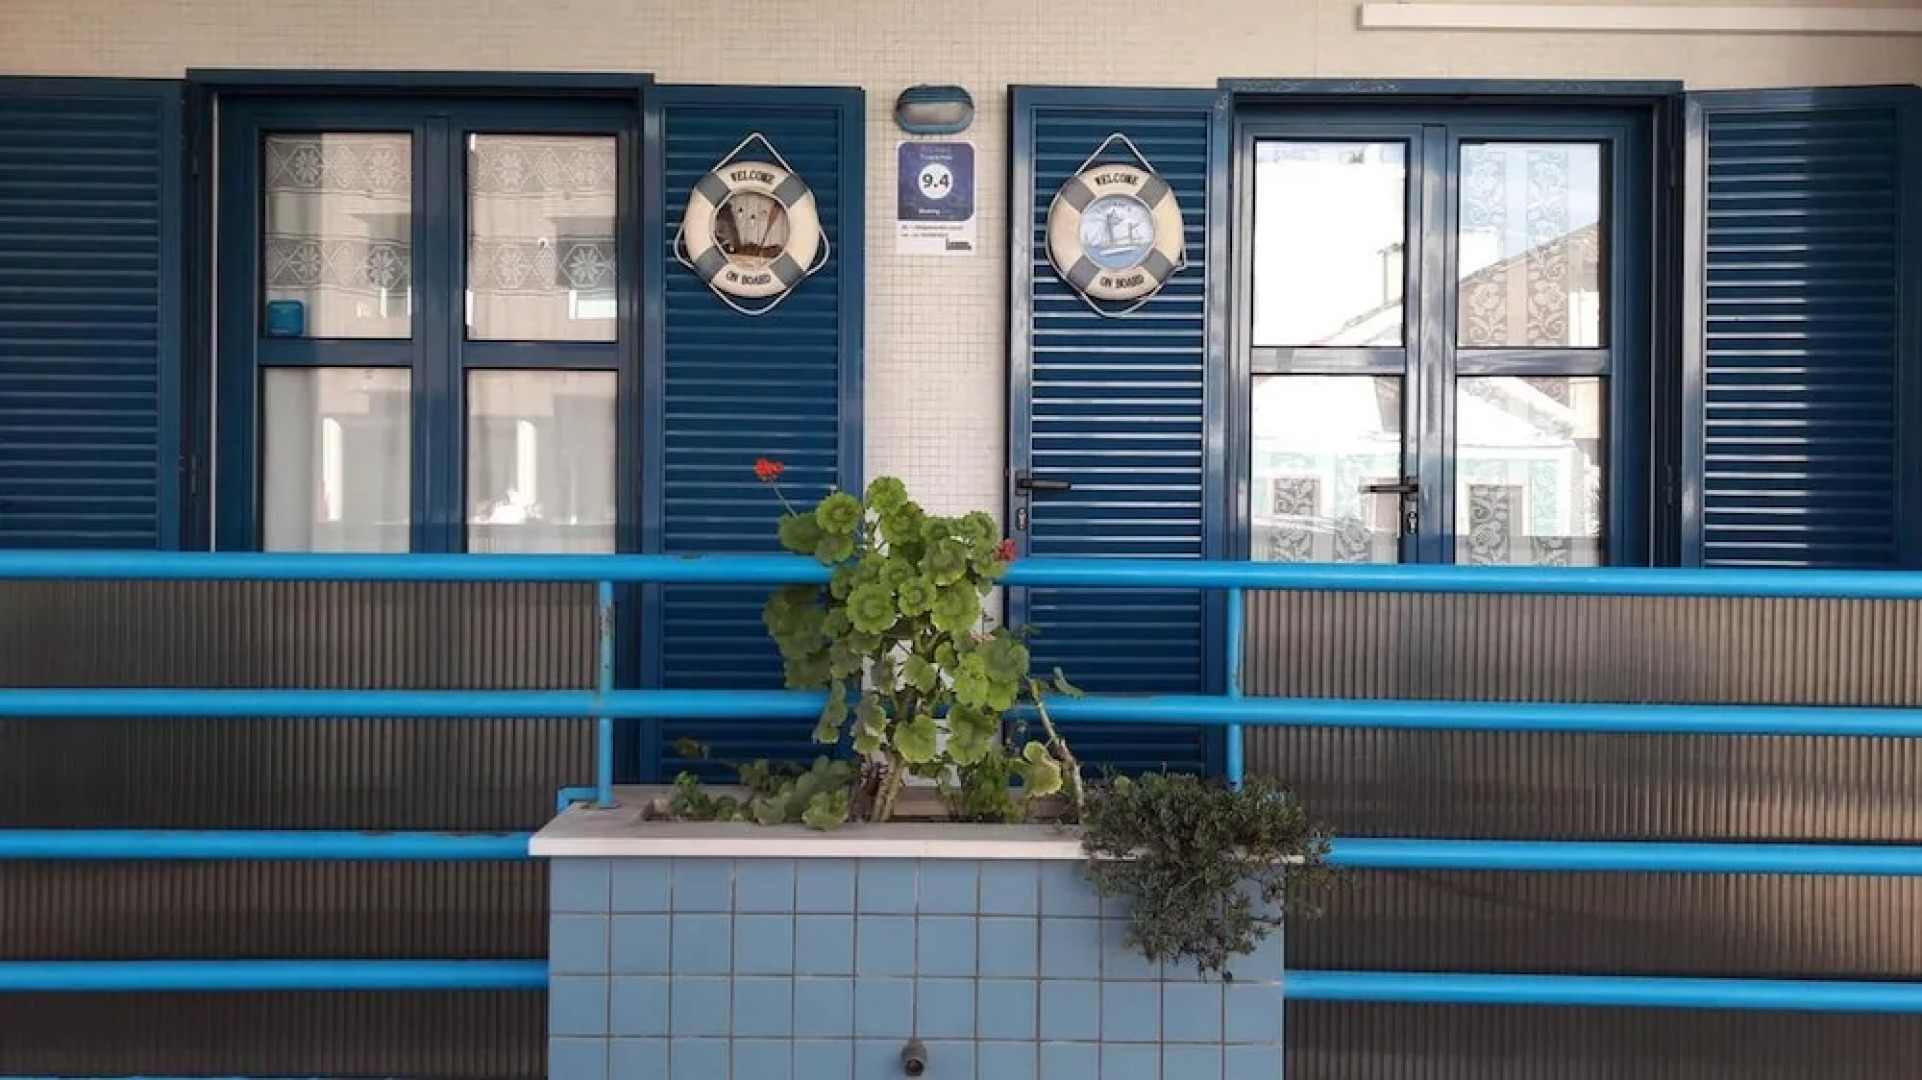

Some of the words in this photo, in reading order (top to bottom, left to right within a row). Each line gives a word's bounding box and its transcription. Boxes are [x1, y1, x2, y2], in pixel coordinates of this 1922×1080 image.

[730, 171, 775, 184] WELCOME
[922, 174, 949, 188] 9.4
[1094, 173, 1138, 186] WELCOME
[726, 271, 738, 282] ON
[742, 275, 771, 285] BOARD
[1100, 276, 1112, 287] ON
[1115, 275, 1144, 288] BOARD
